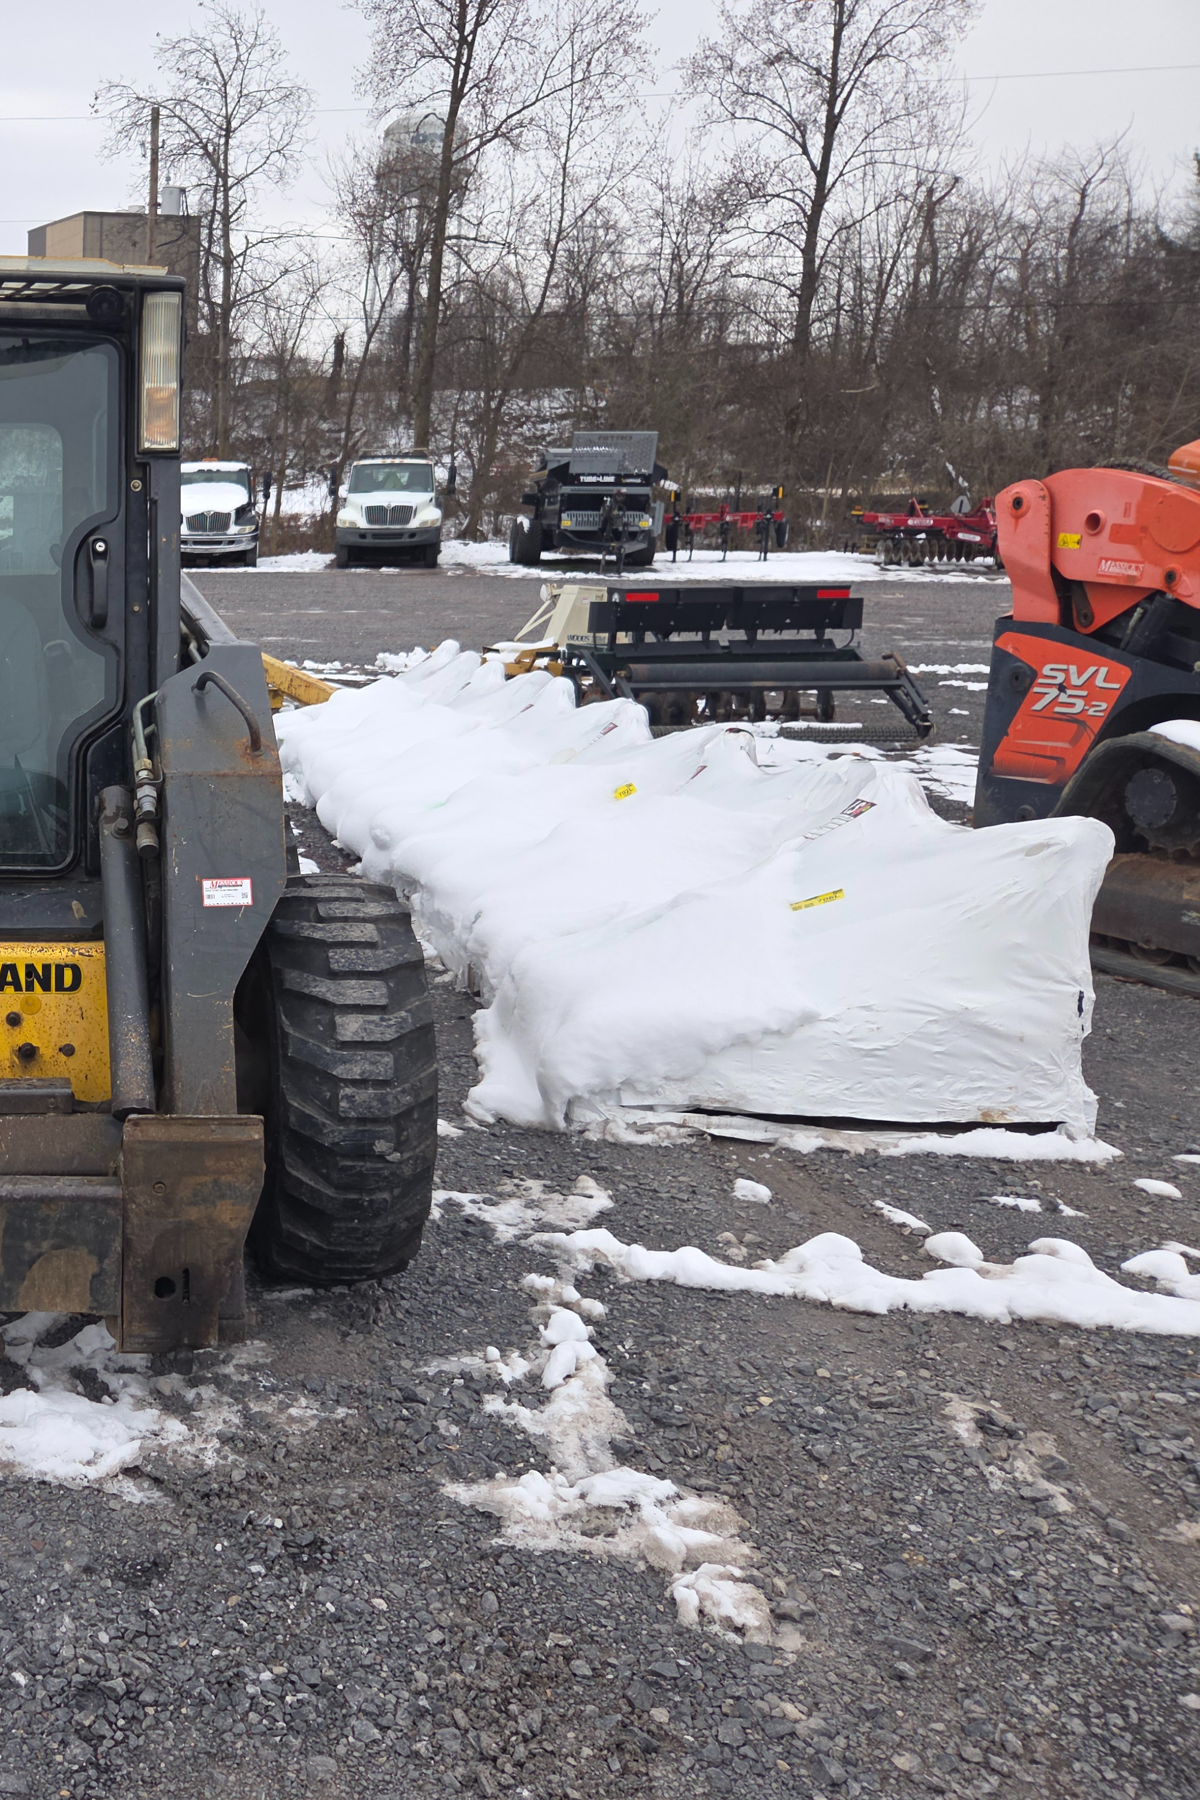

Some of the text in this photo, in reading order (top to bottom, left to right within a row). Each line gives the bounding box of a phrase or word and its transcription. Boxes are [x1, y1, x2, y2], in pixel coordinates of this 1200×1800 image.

[567, 634, 590, 642] WOODS
[1037, 663, 1121, 690] SVL
[1030, 686, 1108, 717] 75-2
